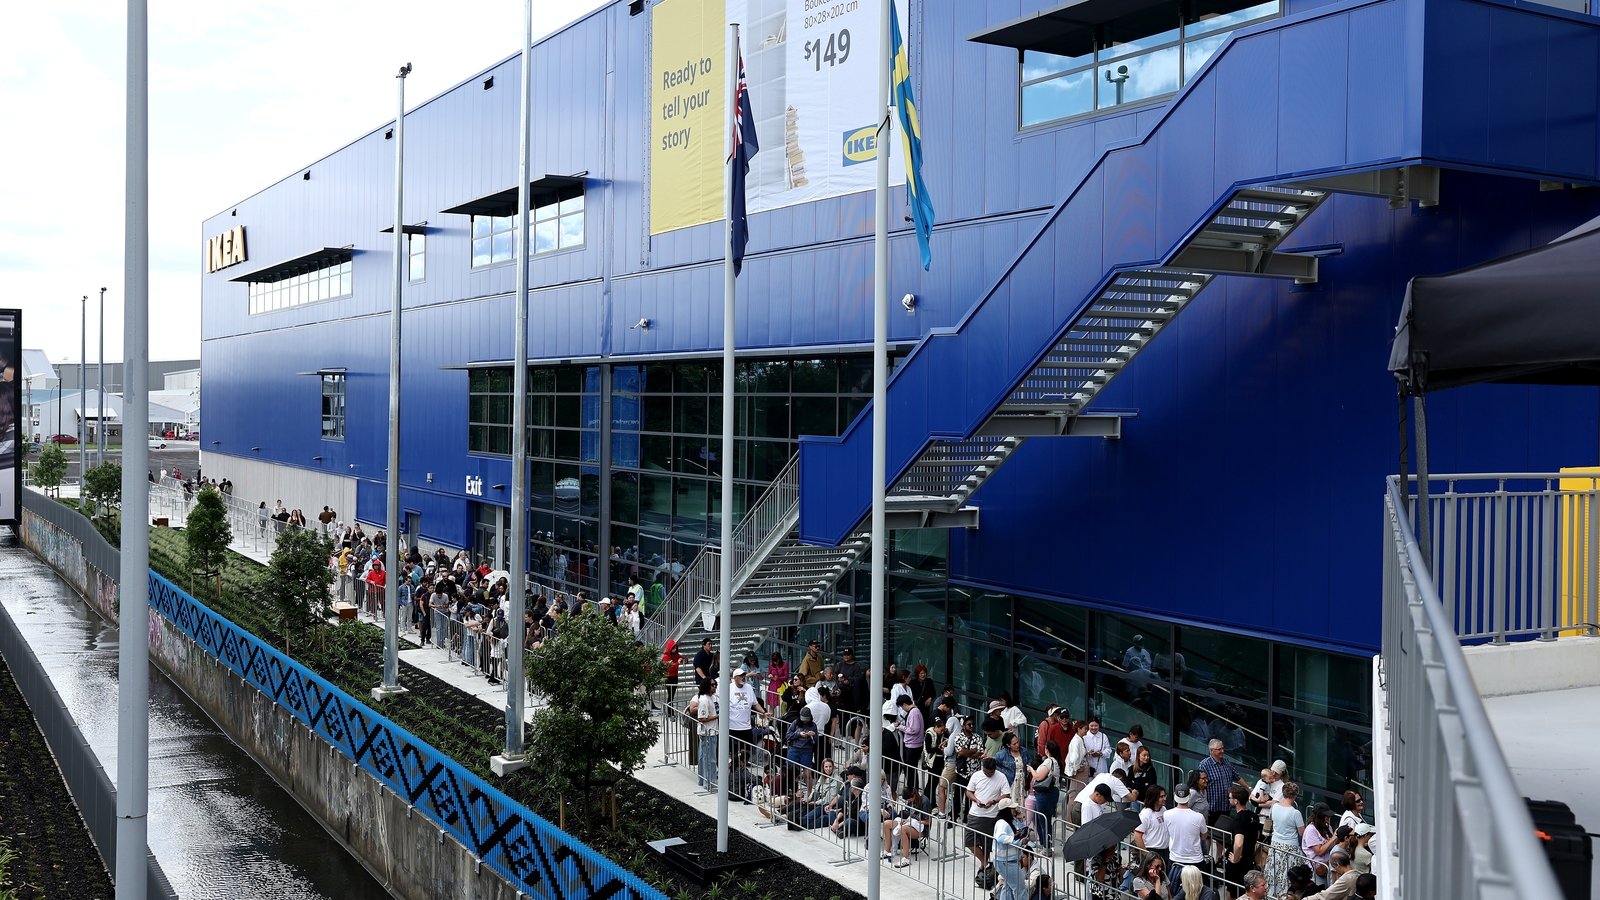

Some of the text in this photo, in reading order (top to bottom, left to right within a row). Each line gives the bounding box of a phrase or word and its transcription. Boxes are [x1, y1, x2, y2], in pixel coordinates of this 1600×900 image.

[846, 1, 858, 13] cm
[804, 28, 851, 72] $149
[663, 57, 712, 90] Ready to
[662, 89, 710, 120] tell your
[662, 127, 691, 150] story
[847, 135, 877, 155] IKE
[206, 225, 248, 273] IKEA
[465, 475, 483, 496] Exit
